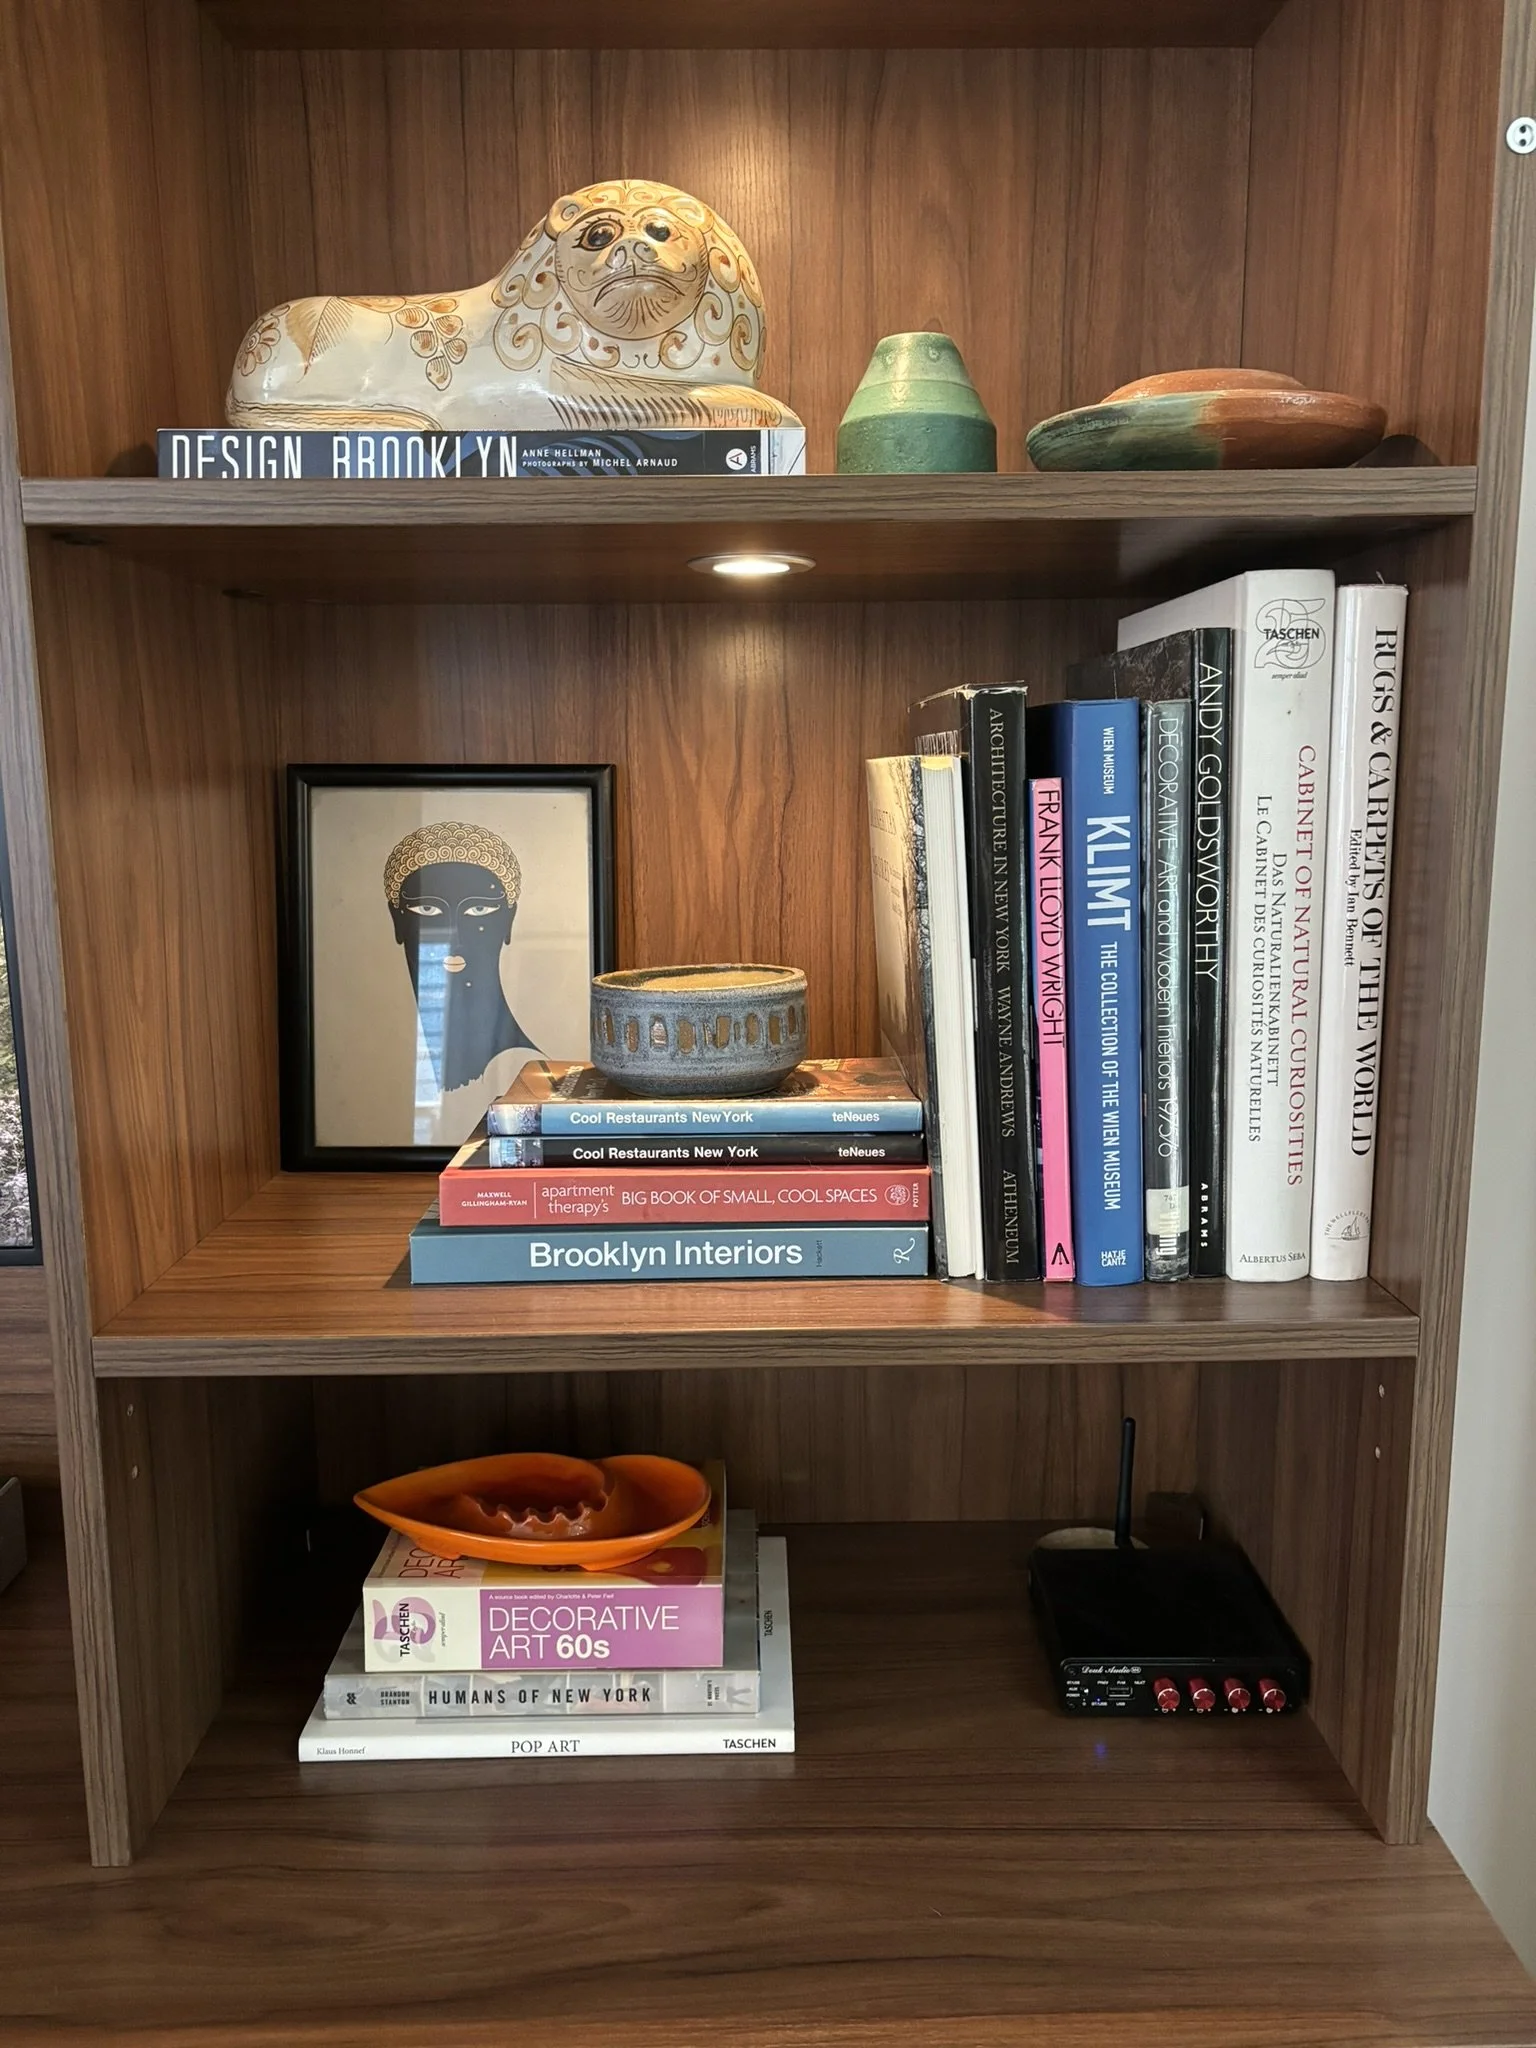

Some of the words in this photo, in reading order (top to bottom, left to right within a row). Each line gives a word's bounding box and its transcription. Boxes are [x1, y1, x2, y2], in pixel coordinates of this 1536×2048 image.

[172, 435, 302, 479] DESIGN
[333, 435, 517, 479] BROOKLYN
[522, 449, 549, 457] ANNE
[554, 449, 601, 457] HELLMAN
[592, 458, 632, 467] MICHEL
[636, 458, 678, 467] ARNAUD
[1263, 628, 1320, 641] TASCHEN
[1371, 625, 1398, 714] RUGS
[1199, 662, 1223, 746] ANDY
[1103, 727, 1116, 752] WIEN
[1369, 721, 1393, 745] &
[989, 708, 1008, 852] ARCHITECTURE
[1103, 754, 1116, 795] MUSEUM
[1158, 718, 1179, 849] DECORATIVE
[1256, 795, 1273, 816] LE
[1295, 745, 1316, 861] CABINET
[1038, 789, 1062, 871] FRANK
[1362, 751, 1392, 900] CARPETS
[992, 856, 1009, 875] IN
[1254, 820, 1273, 899] CABINET
[1348, 829, 1363, 870] Edited
[1086, 815, 1131, 931] KLIMT
[1158, 860, 1179, 894] ART
[1195, 754, 1222, 981] GOLDSWORTHY
[1271, 853, 1288, 887] DAS
[1294, 866, 1314, 899] OF
[1346, 874, 1361, 888] by
[993, 880, 1009, 922] NEW
[1039, 876, 1064, 947] LLOYD
[1157, 900, 1178, 935] and
[1253, 903, 1267, 933] DES
[1346, 891, 1360, 914] Ian
[1343, 918, 1358, 968] Bennett
[1361, 908, 1384, 949] OF
[994, 926, 1011, 973] YORK
[1100, 941, 1118, 969] THE
[1291, 905, 1312, 1023] NATURAL
[1157, 942, 1178, 1017] Modern
[1250, 937, 1268, 1036] CURIOSITÉS
[1267, 891, 1286, 1087] NATURALIENKABINETT
[1356, 957, 1382, 1032] THE
[997, 985, 1013, 1047] WAYNE
[1040, 951, 1066, 1048] WRIGHT
[1100, 972, 1119, 1057] COLLECTION
[1101, 1061, 1119, 1078] OF
[1157, 1024, 1178, 1090] Interiors
[998, 1051, 1016, 1138] ANDREWS
[1101, 1081, 1120, 1107] THE
[1248, 1040, 1262, 1142] NATURELLES
[1287, 1028, 1309, 1186] CURIOSITIES
[1350, 1040, 1378, 1156] WORLD
[570, 1112, 601, 1124] Cool
[606, 1112, 687, 1124] Restaurants
[832, 1111, 880, 1122] teNeues
[1102, 1111, 1120, 1147] WIEN
[1157, 1095, 1179, 1157] 1975/6
[572, 1147, 604, 1160] Cool
[609, 1147, 690, 1159] Restaurants
[694, 1147, 723, 1158] New
[727, 1146, 759, 1158] York
[838, 1147, 886, 1157] teNeues
[541, 1184, 616, 1199] apartment
[622, 1191, 647, 1205] BIG
[650, 1190, 696, 1204] BOOK
[699, 1189, 720, 1204] OF
[723, 1189, 775, 1205] SMALL,
[777, 1188, 823, 1203] COOL
[826, 1188, 878, 1203] SPACES
[1103, 1151, 1121, 1210] MUSEUM
[461, 1199, 527, 1207] GILLINGHAM-RYAN
[548, 1199, 609, 1216] therapy's
[1002, 1169, 1020, 1264] ATHENEUM
[1200, 1182, 1209, 1247] ABRAMS
[530, 1241, 666, 1272] Brooklyn
[675, 1239, 803, 1265] Interiors
[1101, 1250, 1126, 1259] HATJE
[1101, 1257, 1126, 1267] CANTZ
[1239, 1253, 1287, 1263] ALBERTUS
[1287, 1251, 1306, 1262] SEBA
[547, 1593, 555, 1601] by
[399, 1602, 411, 1658] TASCHEN
[489, 1605, 680, 1632] DECORATIVE
[764, 1610, 773, 1637] TASCHEN
[489, 1634, 551, 1660] ART
[556, 1634, 610, 1659] 60s
[1104, 1666, 1131, 1674] Audio
[428, 1690, 506, 1705] HUMANS
[518, 1689, 540, 1704] OF
[552, 1688, 591, 1703] NEW
[603, 1687, 651, 1702] YORK
[316, 1746, 336, 1755] Klaus
[338, 1746, 366, 1755] Honnef
[510, 1740, 543, 1753] POP
[547, 1739, 580, 1753] ART
[722, 1738, 776, 1749] TASCHEN
